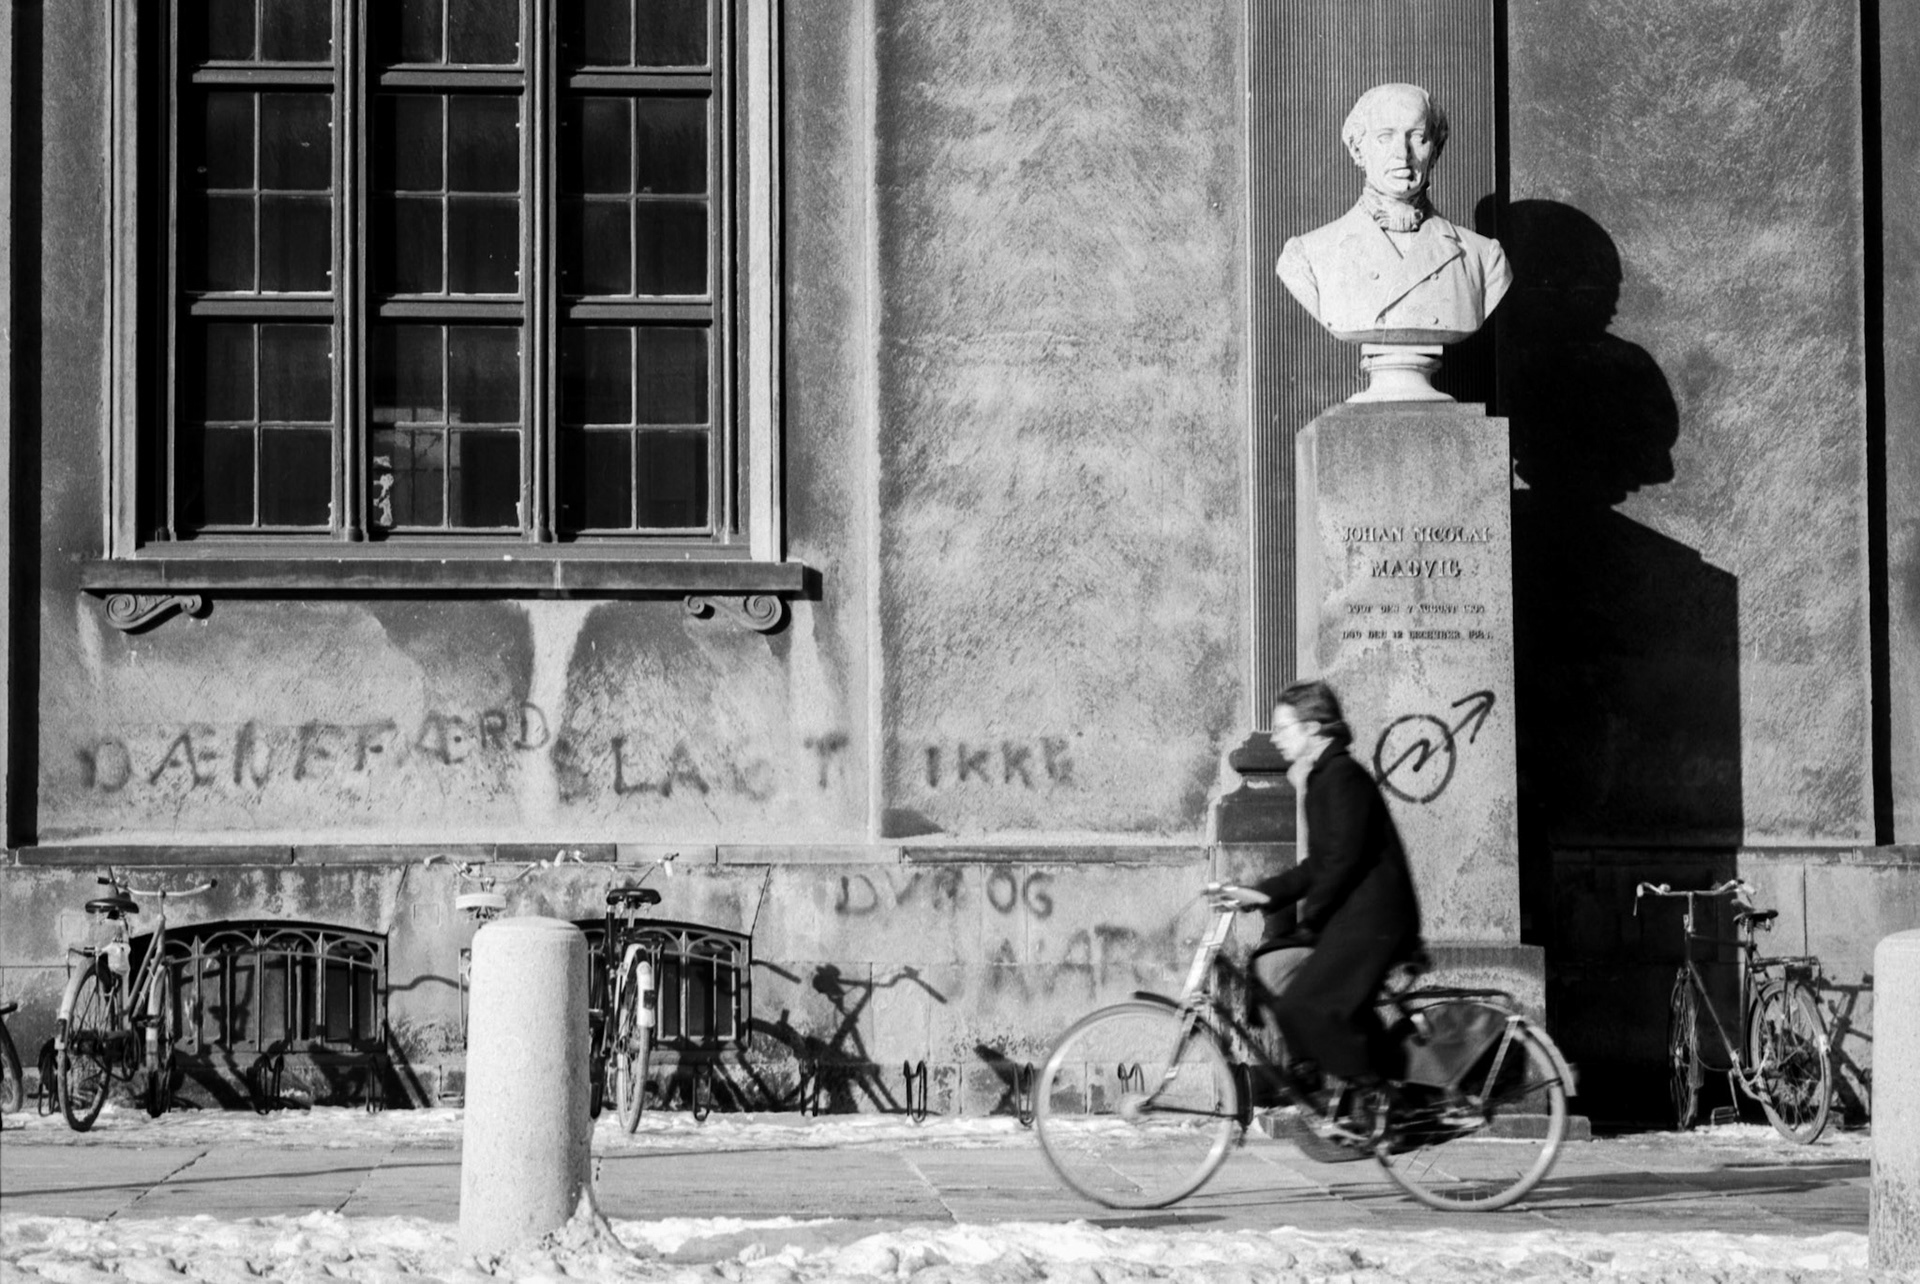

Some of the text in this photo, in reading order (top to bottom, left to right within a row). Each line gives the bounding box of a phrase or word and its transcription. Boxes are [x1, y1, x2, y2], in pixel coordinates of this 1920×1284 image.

[1342, 527, 1490, 543] JOHAN NICOLAI
[1371, 559, 1462, 578] MADVIG
[986, 864, 1055, 920] OG
